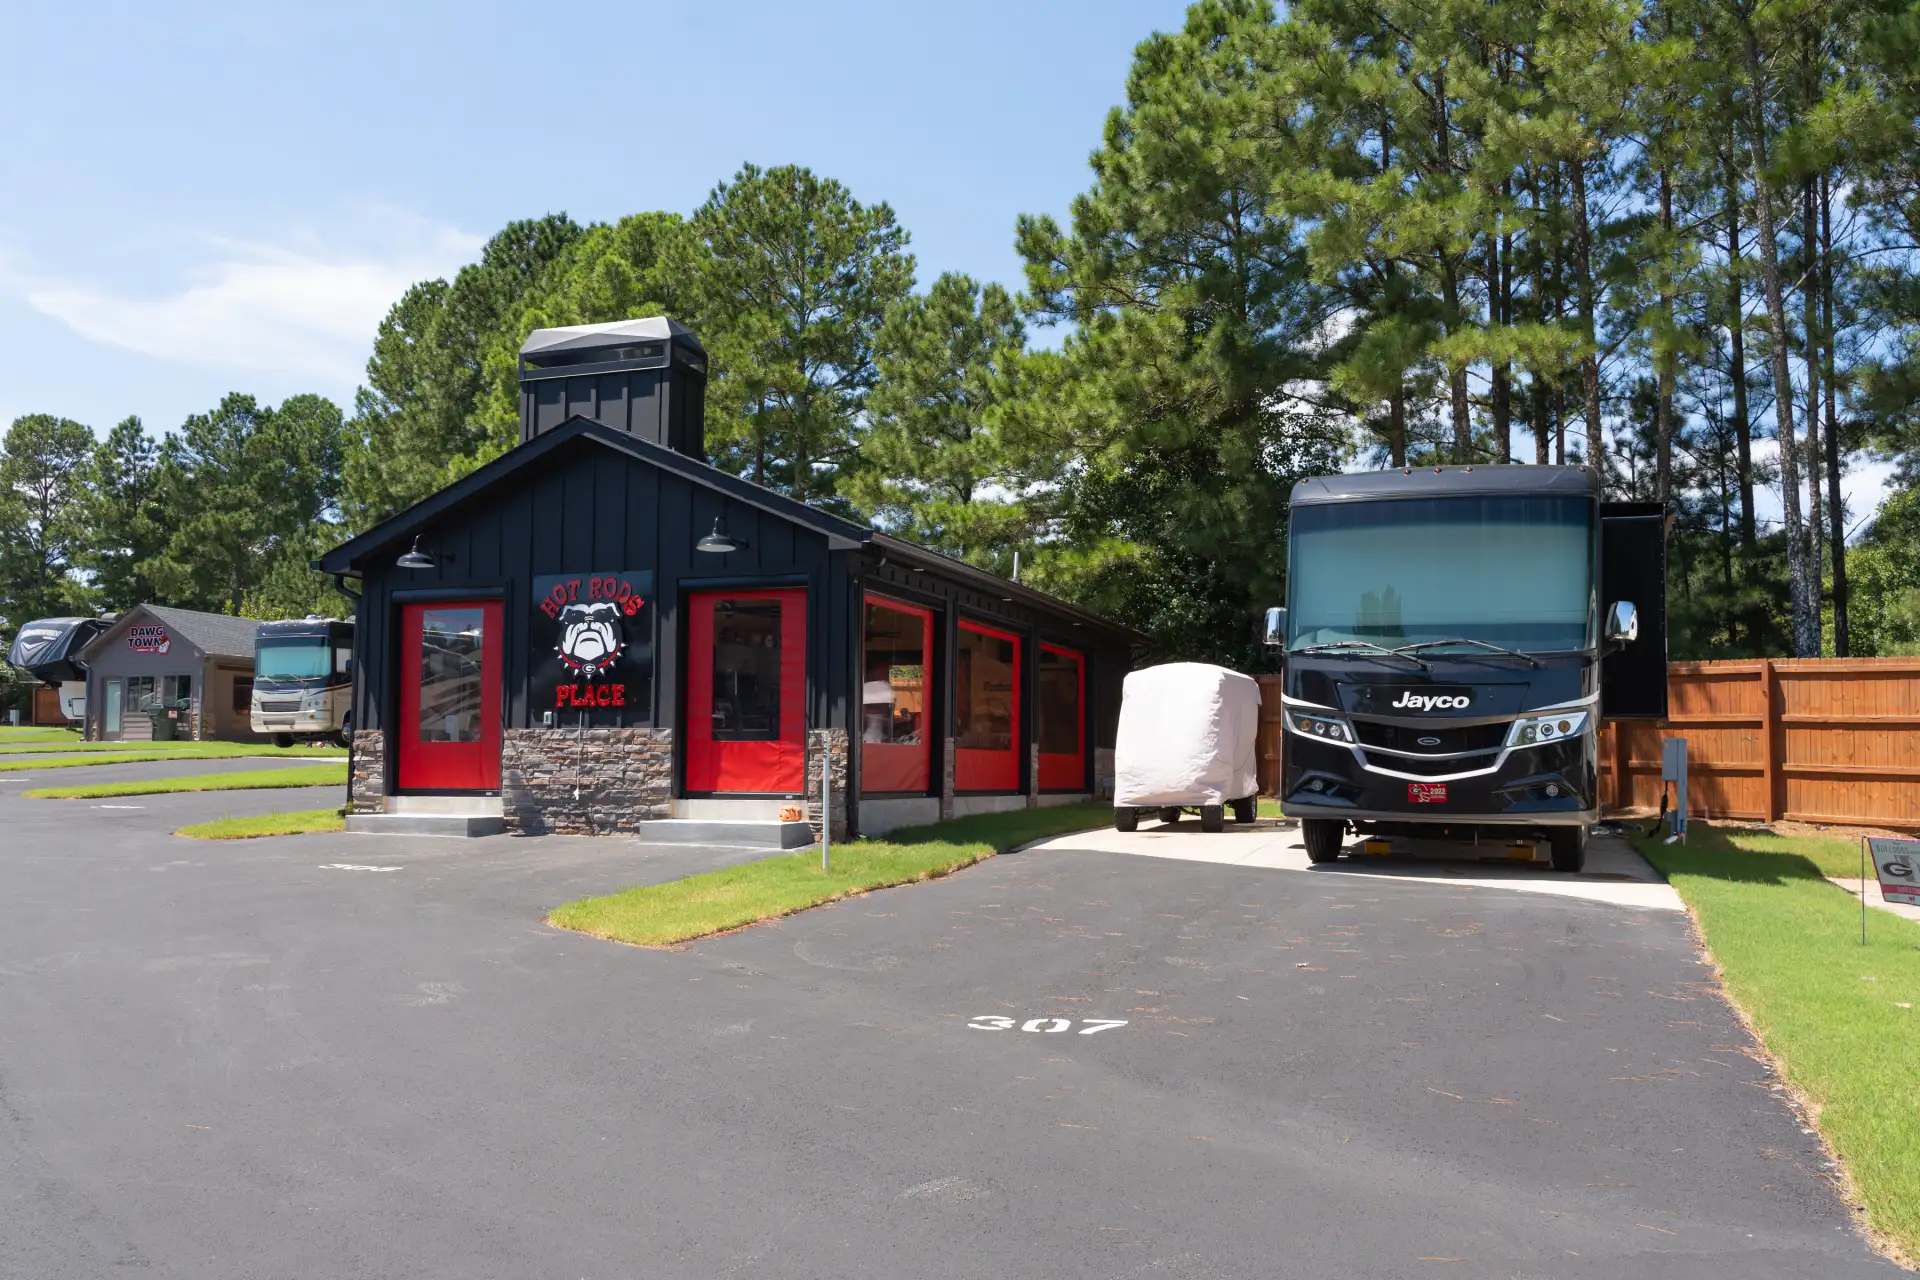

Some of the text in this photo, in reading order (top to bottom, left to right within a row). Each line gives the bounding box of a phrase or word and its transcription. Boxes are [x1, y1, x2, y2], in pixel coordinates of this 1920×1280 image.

[540, 576, 645, 620] HOT RODS
[131, 626, 163, 636] DAWG
[127, 637, 161, 648] TOWN
[555, 683, 625, 707] PLACE
[1392, 691, 1470, 712] Jayco
[1882, 862, 1913, 877] G
[967, 1015, 1129, 1035] 307
